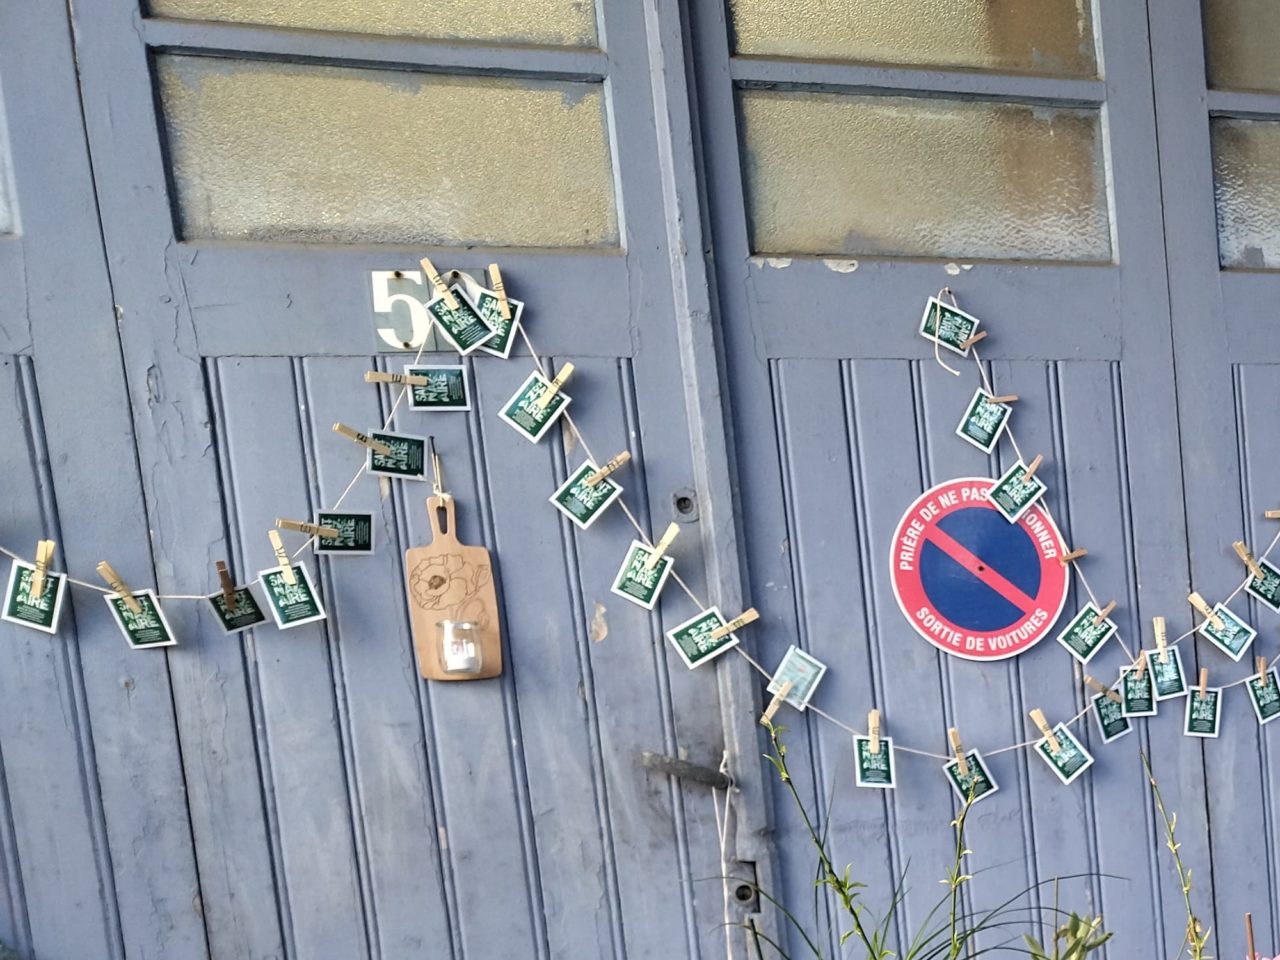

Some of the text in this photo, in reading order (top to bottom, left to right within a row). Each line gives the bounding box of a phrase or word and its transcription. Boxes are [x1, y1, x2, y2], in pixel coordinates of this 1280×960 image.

[900, 518, 925, 571] PRIÈRE
[919, 501, 940, 521] DE
[938, 491, 959, 509] NE
[961, 487, 989, 502] PAS
[916, 606, 1048, 651] SORTIE DE VOITURES
